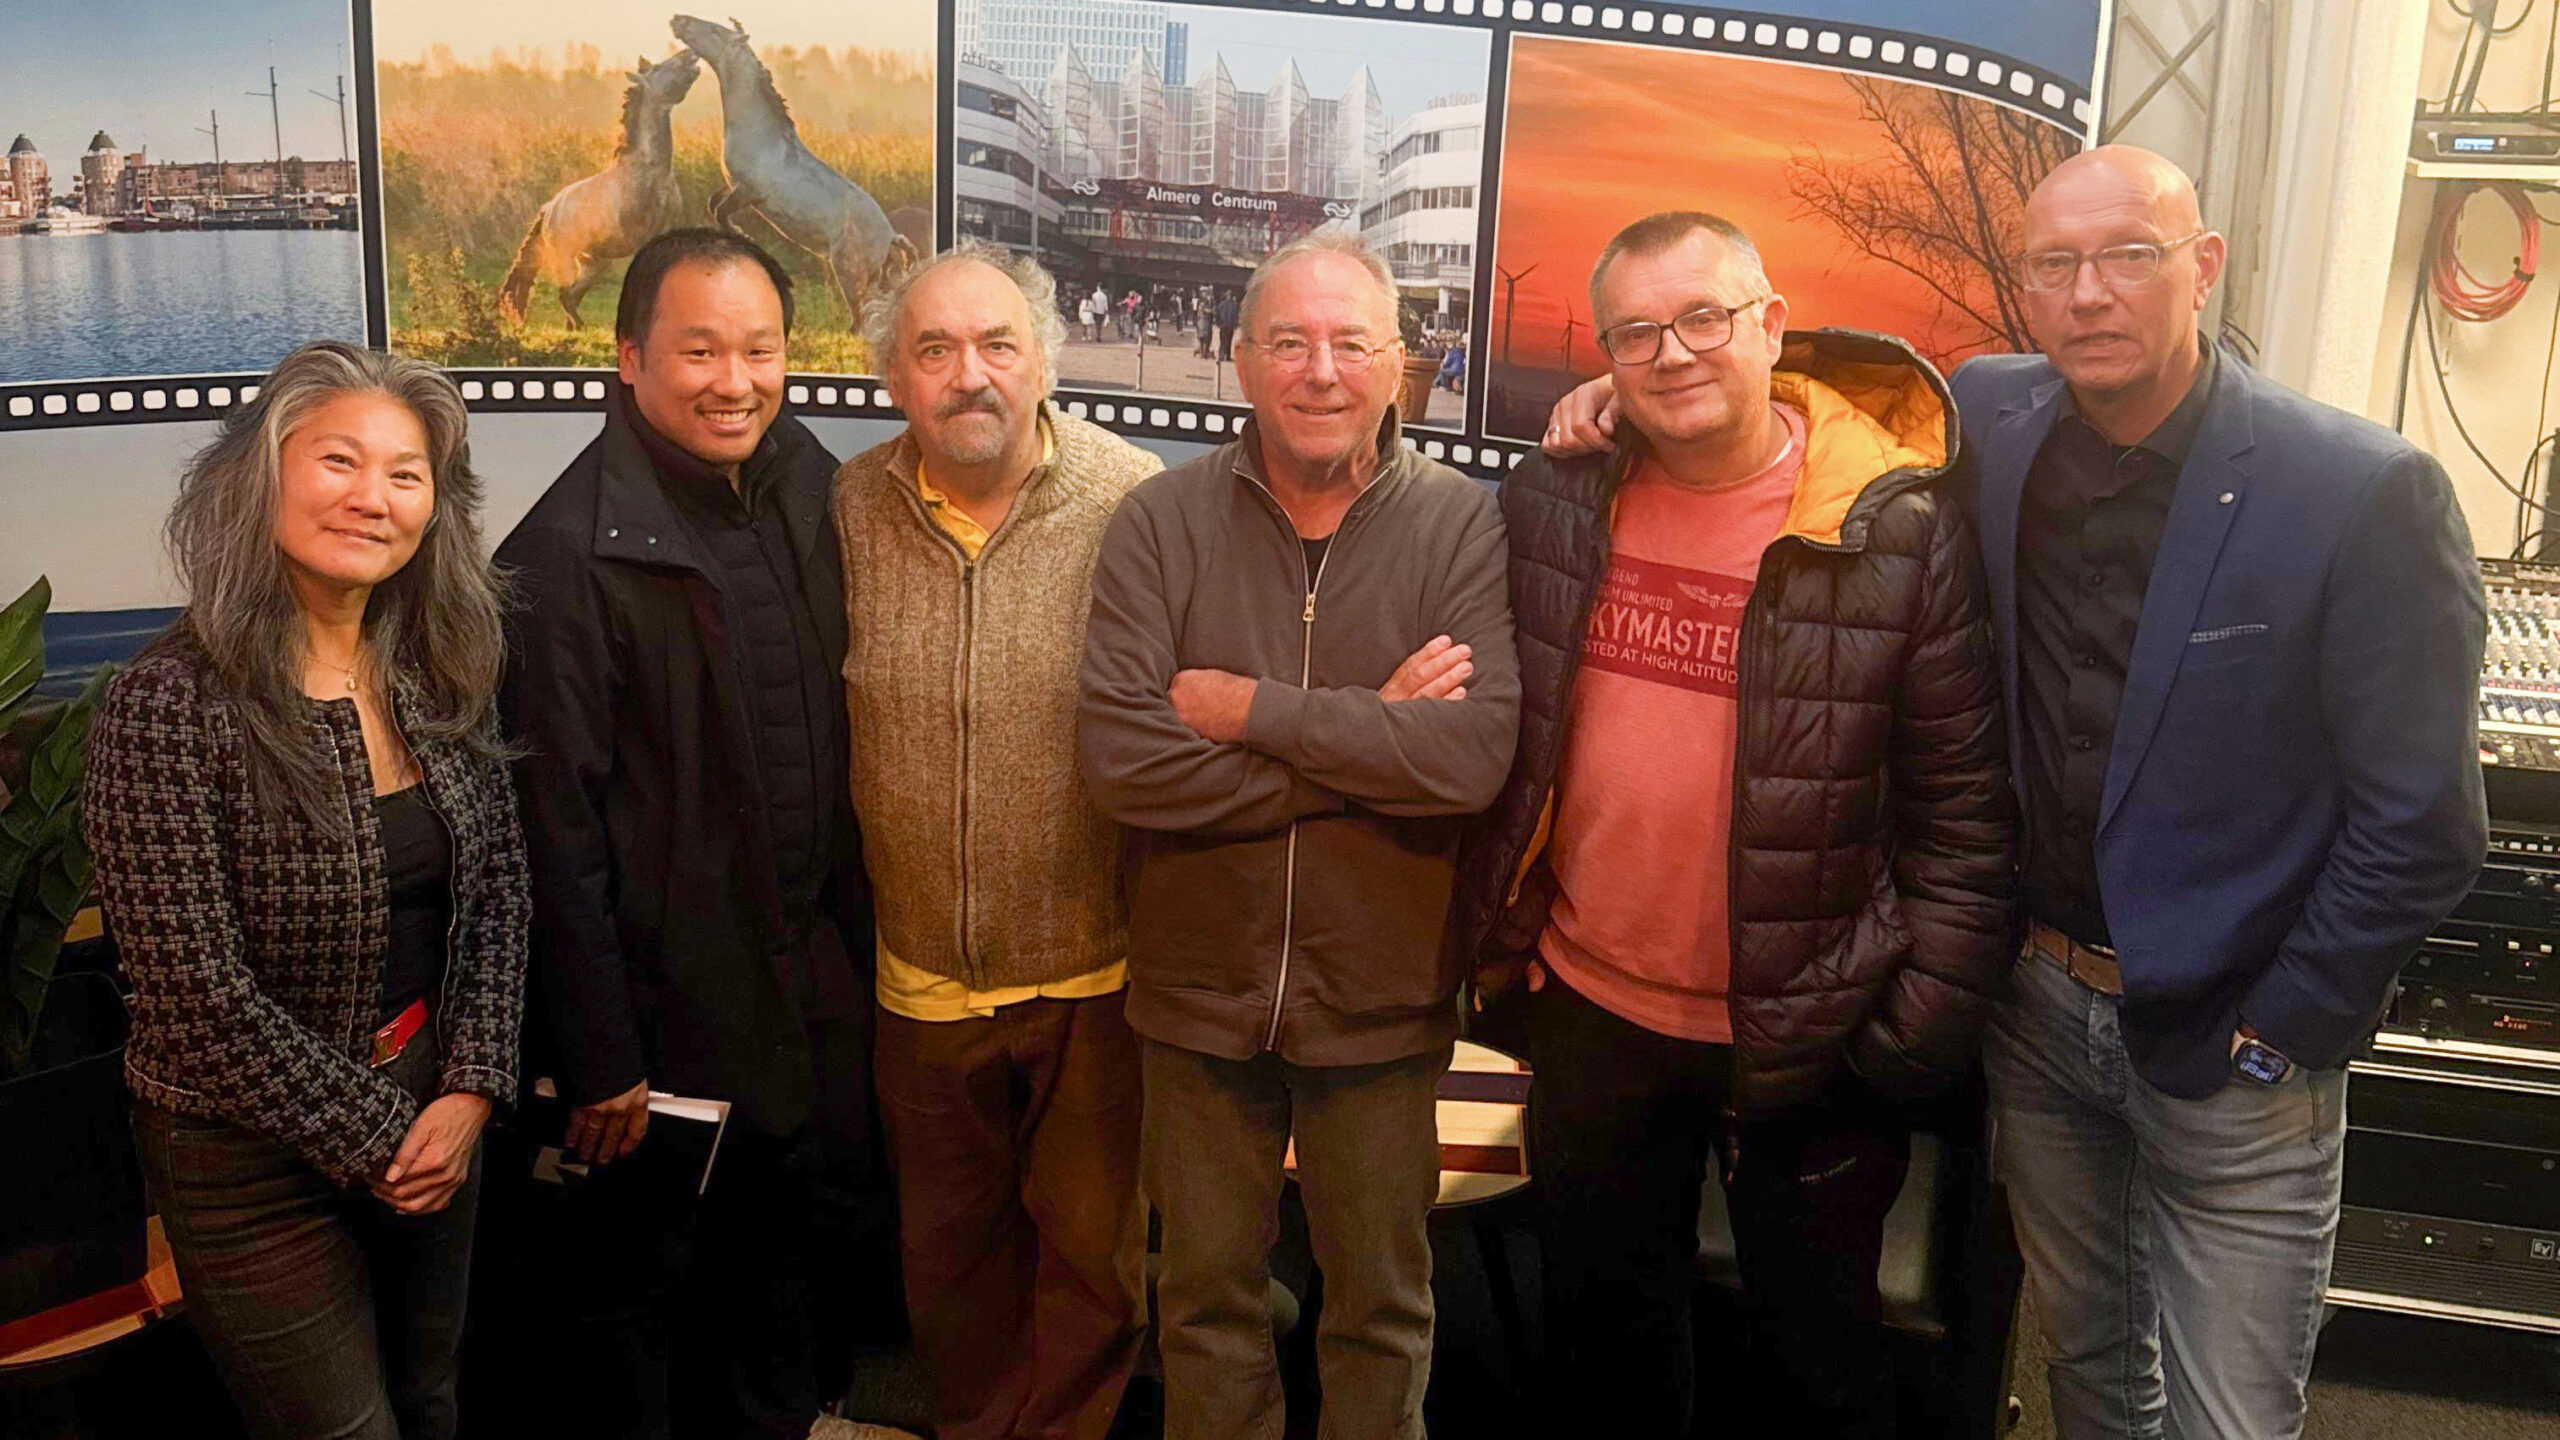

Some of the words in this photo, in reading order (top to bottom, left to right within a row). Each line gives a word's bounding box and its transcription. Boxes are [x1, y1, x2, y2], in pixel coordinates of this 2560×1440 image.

[1146, 186, 1201, 205] Almere
[1211, 191, 1278, 211] Centrum
[1621, 588, 1673, 612] UNLIMITED
[1620, 647, 1639, 662] AT
[1641, 652, 1679, 672] HIGH
